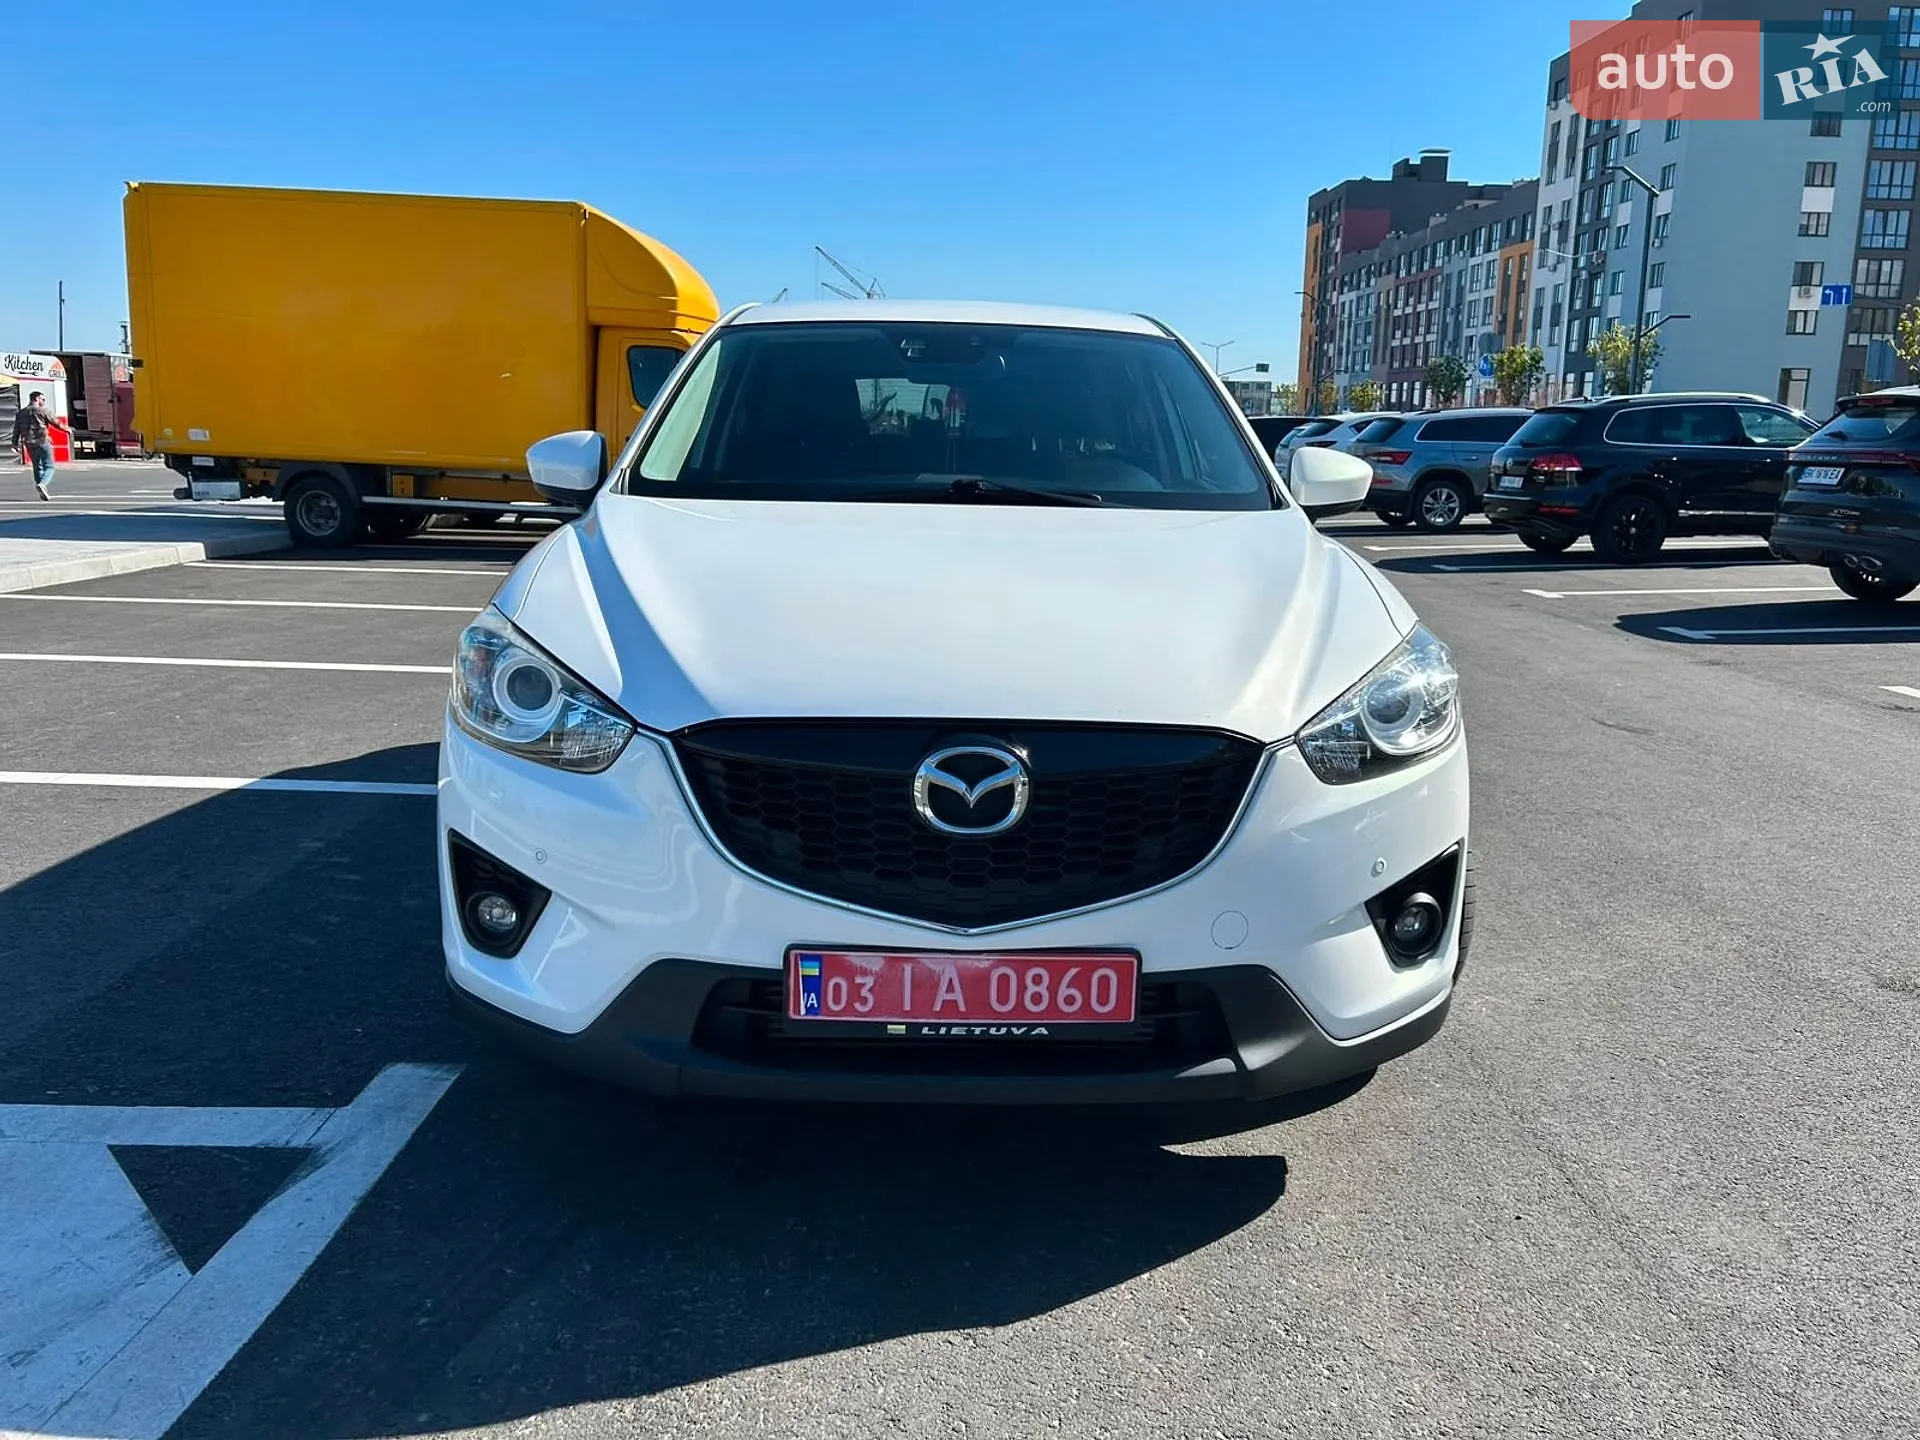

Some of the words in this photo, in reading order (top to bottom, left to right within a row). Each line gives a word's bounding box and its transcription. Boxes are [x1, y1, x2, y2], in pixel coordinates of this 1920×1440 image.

[4, 354, 43, 371] Kitchen
[826, 975, 875, 1013] 03
[902, 963, 967, 1012] IA
[989, 966, 1118, 1013] 0860
[921, 1025, 1049, 1036] LIETUVA
